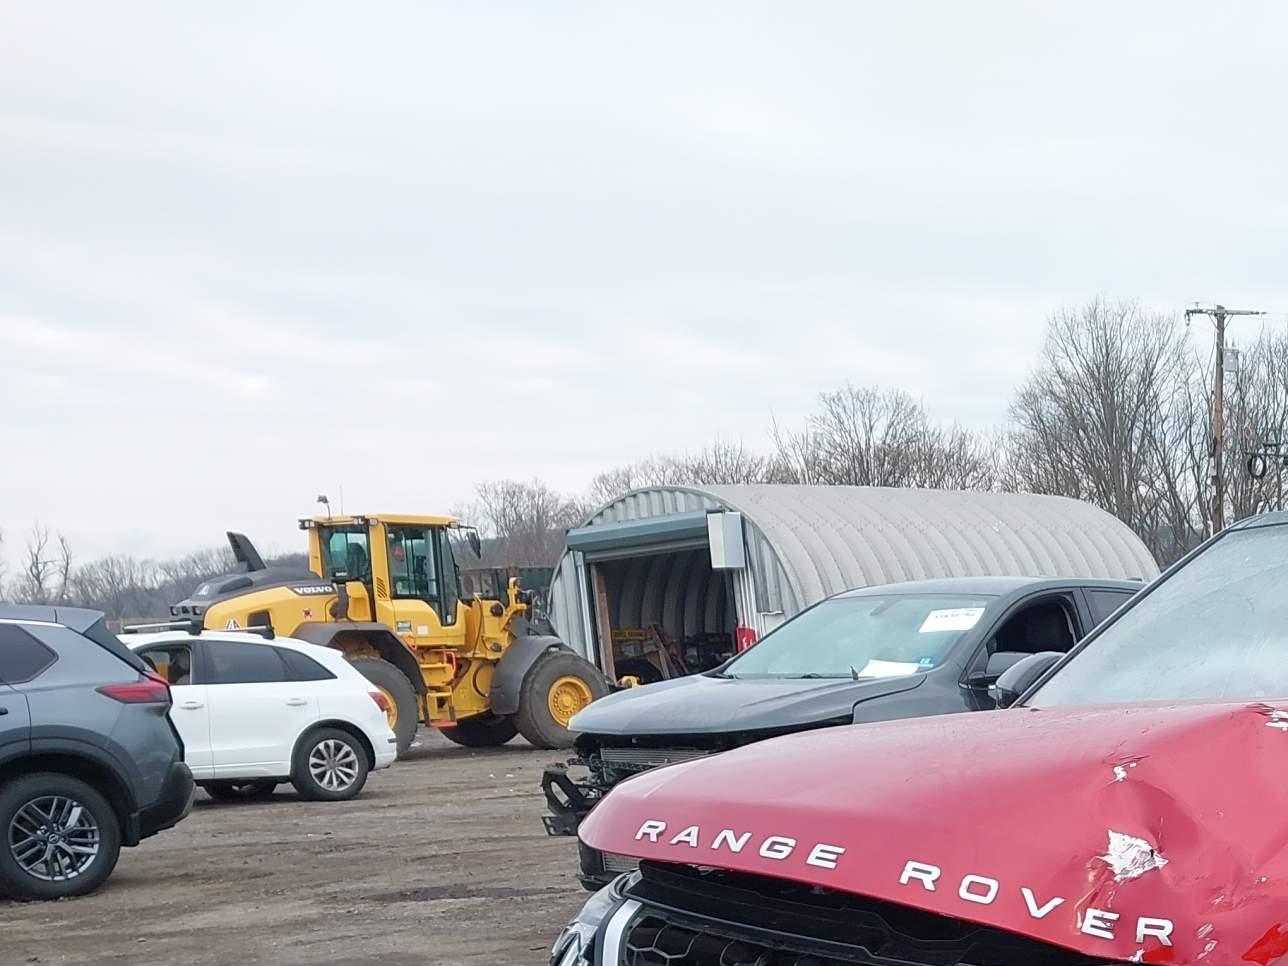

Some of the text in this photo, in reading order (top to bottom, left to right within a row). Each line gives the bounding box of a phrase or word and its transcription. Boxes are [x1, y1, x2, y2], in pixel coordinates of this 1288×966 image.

[294, 586, 333, 594] VOLVO
[635, 819, 1175, 947] RANGE ROVER
